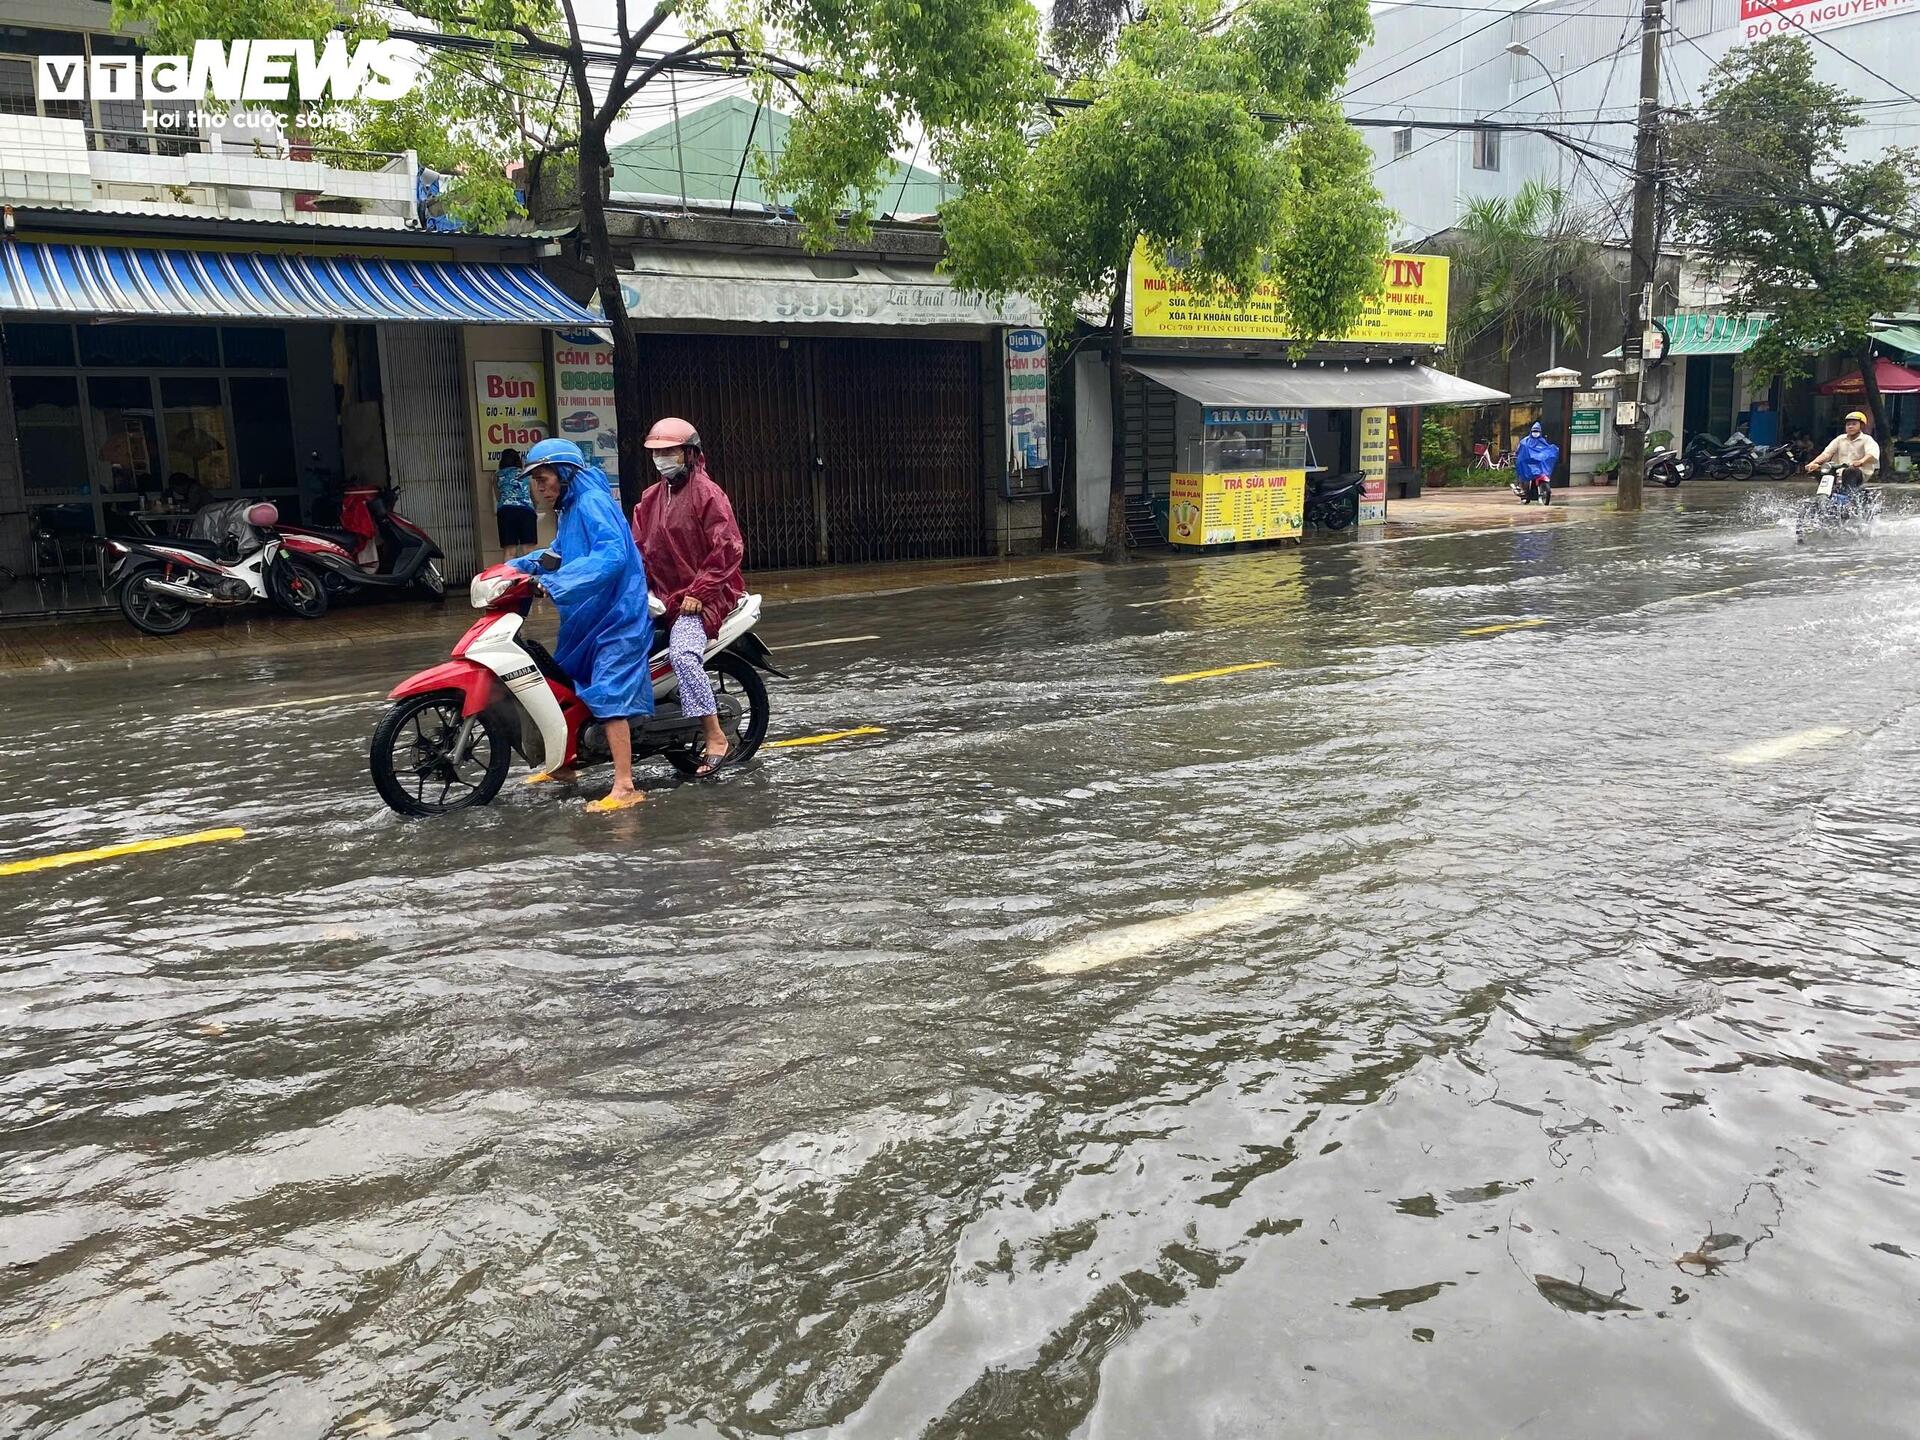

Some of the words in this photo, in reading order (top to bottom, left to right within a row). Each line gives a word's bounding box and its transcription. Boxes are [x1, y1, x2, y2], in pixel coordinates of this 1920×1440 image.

[1144, 278, 1167, 291] MUA
[1009, 335, 1029, 348] Dịch
[1031, 335, 1042, 348] Vụ
[487, 375, 536, 398] Bún
[1278, 408, 1305, 421] WIN
[487, 423, 542, 445] Cháo
[1267, 476, 1287, 488] WIN
[504, 667, 532, 681] YAMAHA
